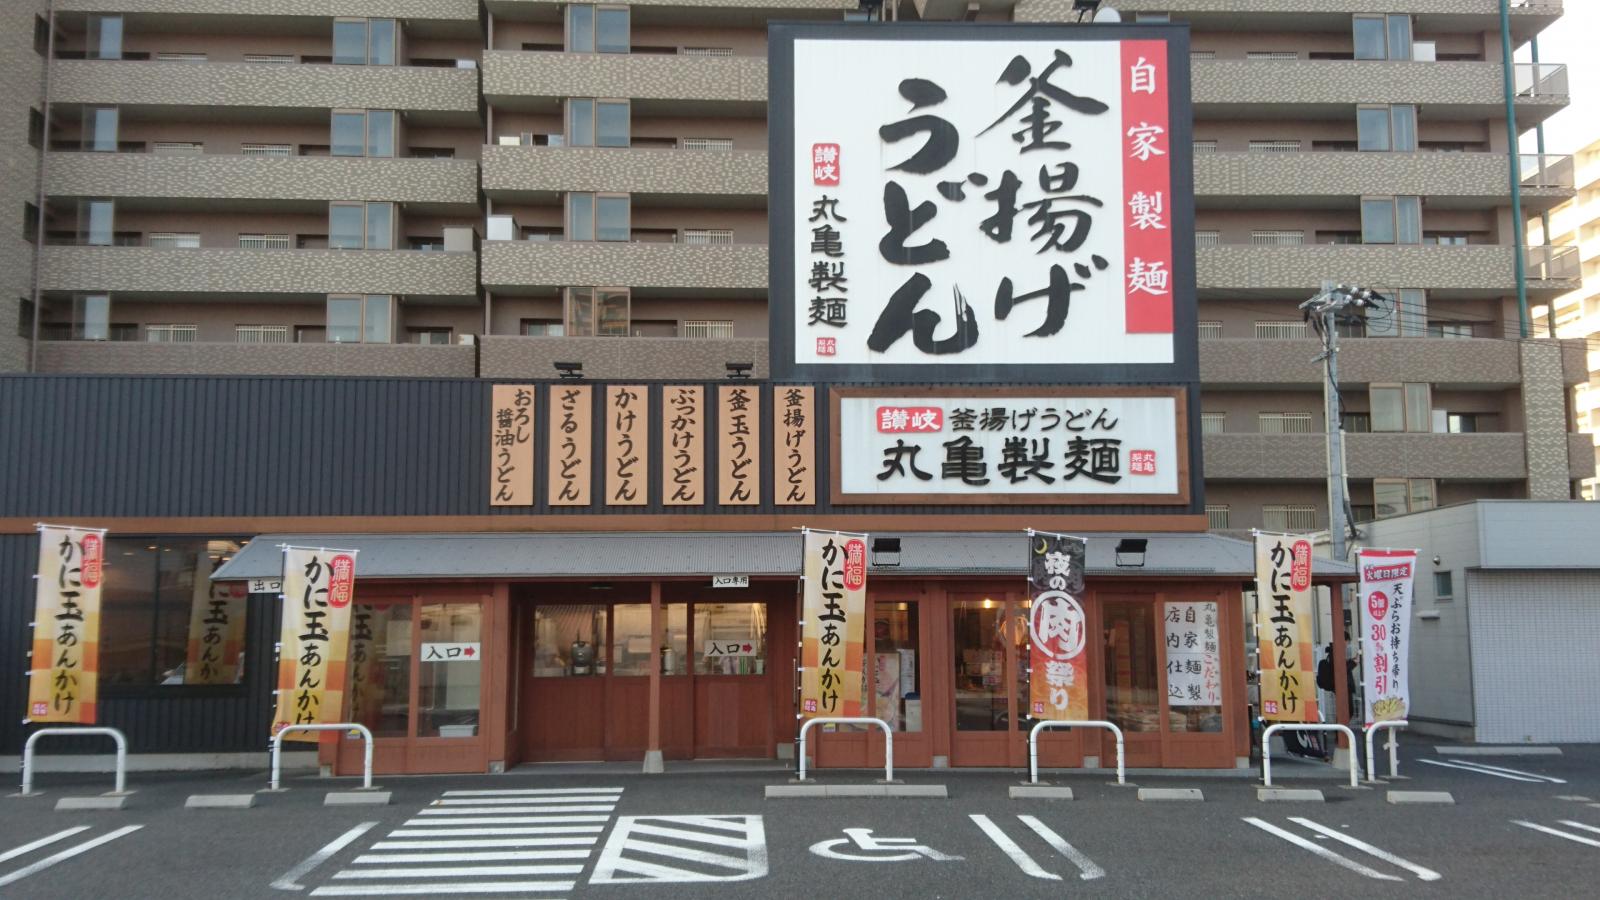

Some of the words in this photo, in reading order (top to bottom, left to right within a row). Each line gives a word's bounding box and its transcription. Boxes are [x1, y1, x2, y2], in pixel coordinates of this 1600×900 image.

[866, 77, 989, 356] うどん
[974, 48, 1110, 338] 釜揚げ
[1126, 56, 1169, 296] 自家製麺
[808, 194, 848, 328] 丸亀製麺
[514, 388, 532, 444] おろし
[558, 389, 582, 501] ざるうどん
[614, 387, 639, 501] かけうどん
[670, 388, 698, 502] ぶっかけうどん
[727, 388, 752, 502] 釜玉うどん
[783, 388, 807, 502] 釜揚げうどん
[876, 435, 1123, 487] 丸亀製麺
[948, 407, 1121, 432] 釜揚げうどん
[54, 534, 85, 716] かに玉あんかけ
[254, 580, 280, 592] 出口
[817, 538, 850, 713] かに玉あんかけ
[1269, 540, 1299, 714] かに玉あんかけ
[296, 555, 335, 735] かに玉あんかけ
[426, 645, 462, 660] 入口
[710, 642, 740, 655] 入口
